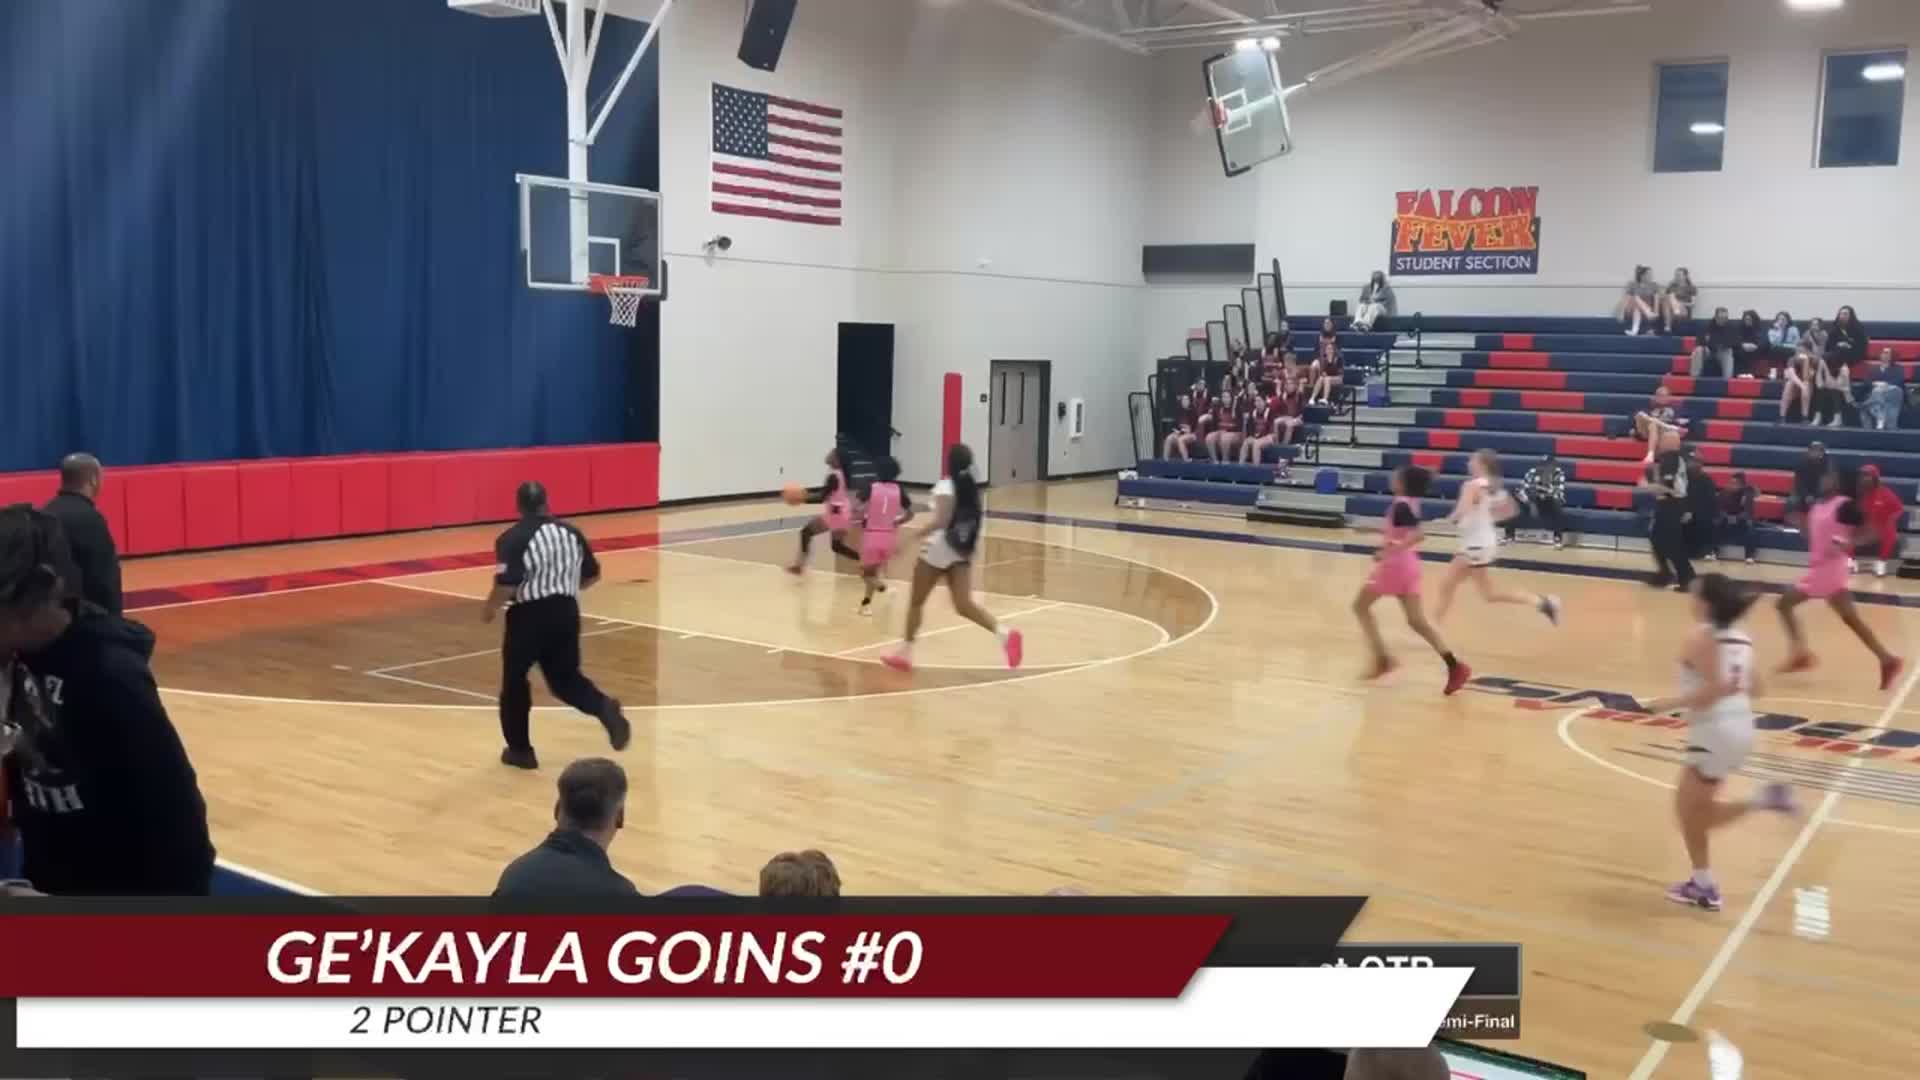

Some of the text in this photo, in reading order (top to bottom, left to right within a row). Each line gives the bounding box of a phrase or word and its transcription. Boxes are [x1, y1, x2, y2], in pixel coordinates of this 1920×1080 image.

[1396, 187, 1539, 218] FALCON
[1394, 214, 1537, 252] FEVER
[1396, 255, 1531, 271] STUDENT SECTION
